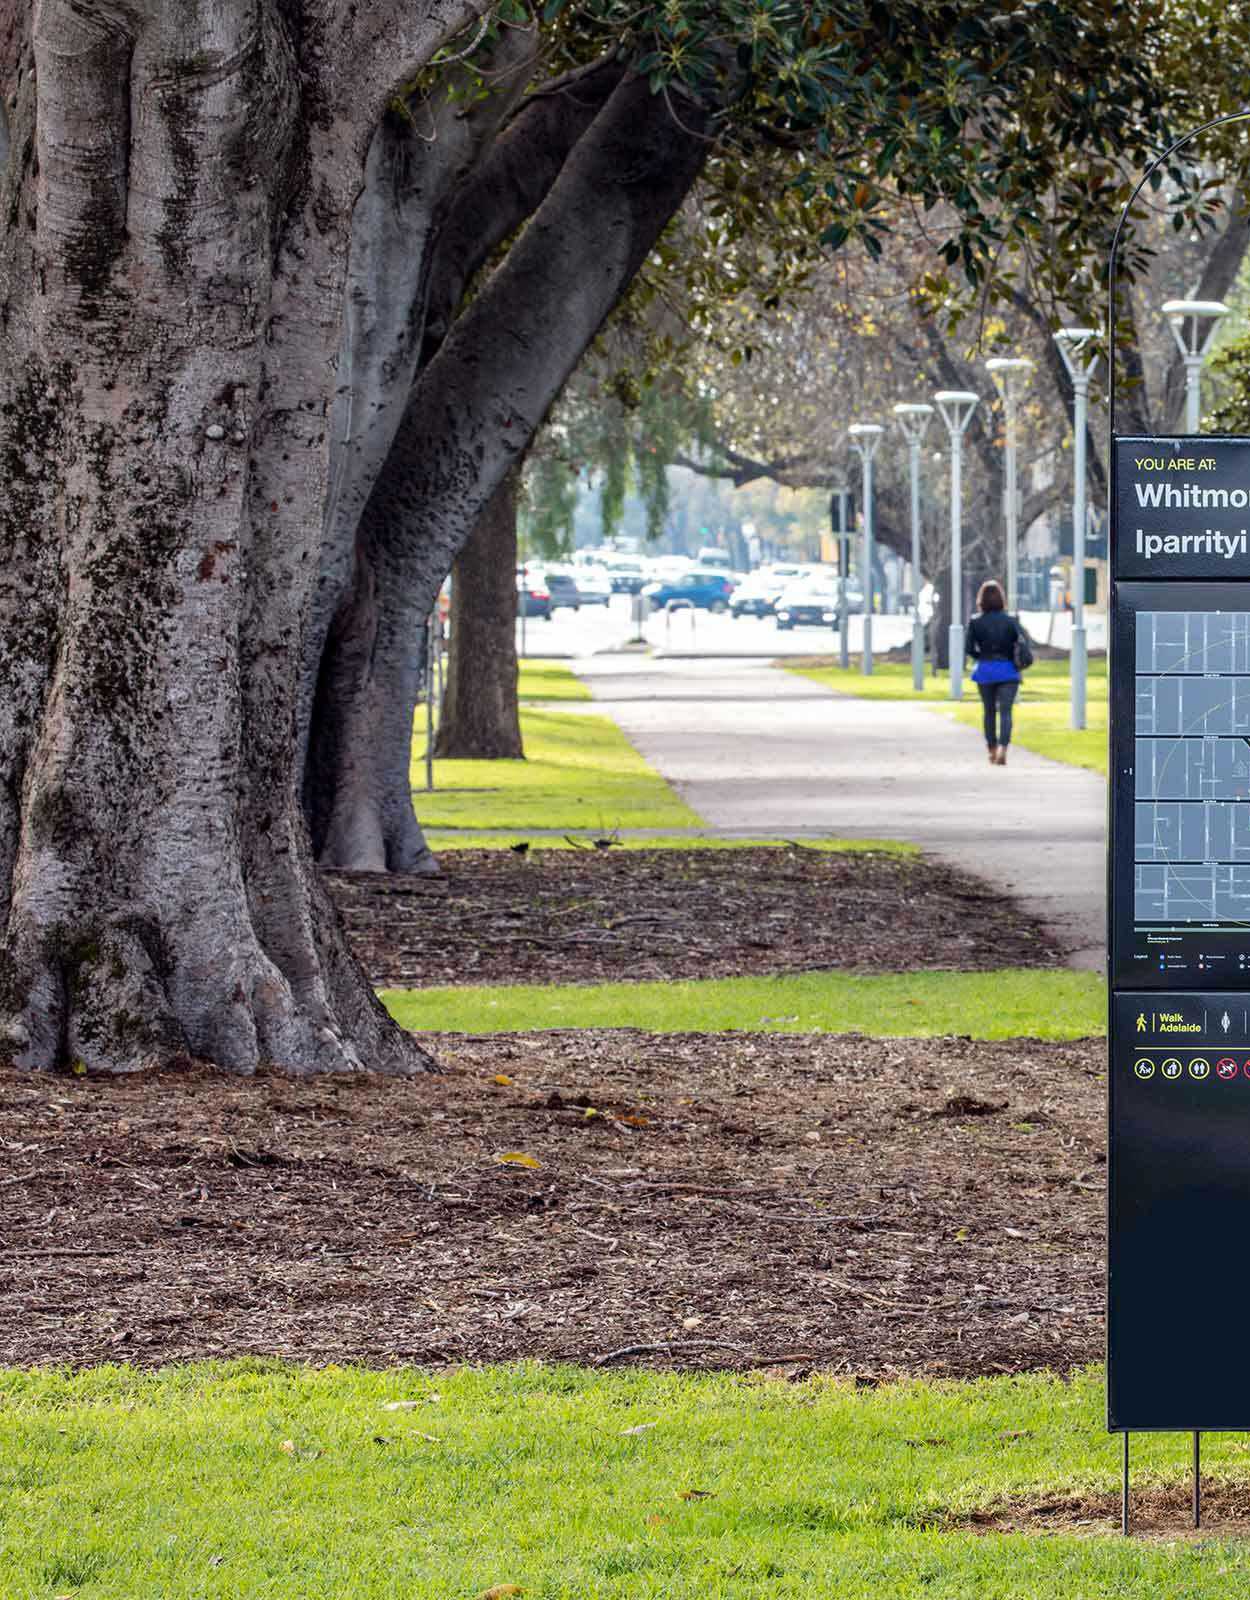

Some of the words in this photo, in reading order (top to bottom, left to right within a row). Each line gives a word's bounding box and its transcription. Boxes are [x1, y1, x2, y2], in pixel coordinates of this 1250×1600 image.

[1135, 459, 1164, 470] YOU
[1168, 459, 1194, 470] ARE
[1198, 459, 1216, 470] AT:
[1136, 530, 1247, 558] Iparrityi
[1160, 1013, 1184, 1022] Walk
[1159, 1023, 1202, 1033] Adelaide
